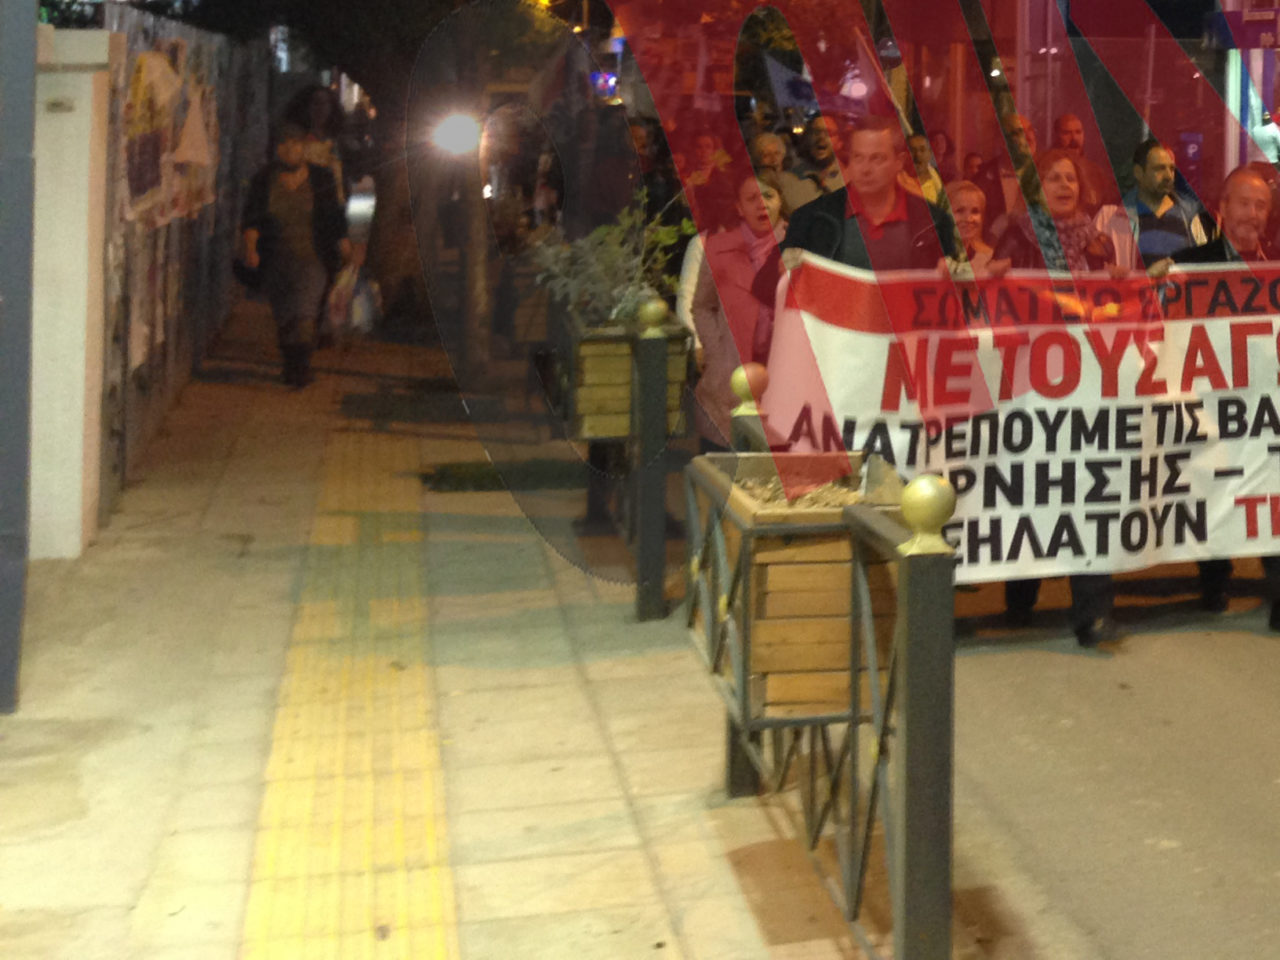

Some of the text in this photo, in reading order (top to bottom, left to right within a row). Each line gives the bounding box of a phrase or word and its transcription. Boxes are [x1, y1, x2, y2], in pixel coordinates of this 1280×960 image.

[992, 326, 1168, 401] ΤΟΥΣ
[787, 401, 1143, 467] ΑΝΑΤΡΕΠΟΥΜΕ
[1151, 401, 1209, 446] ΤΙΣ
